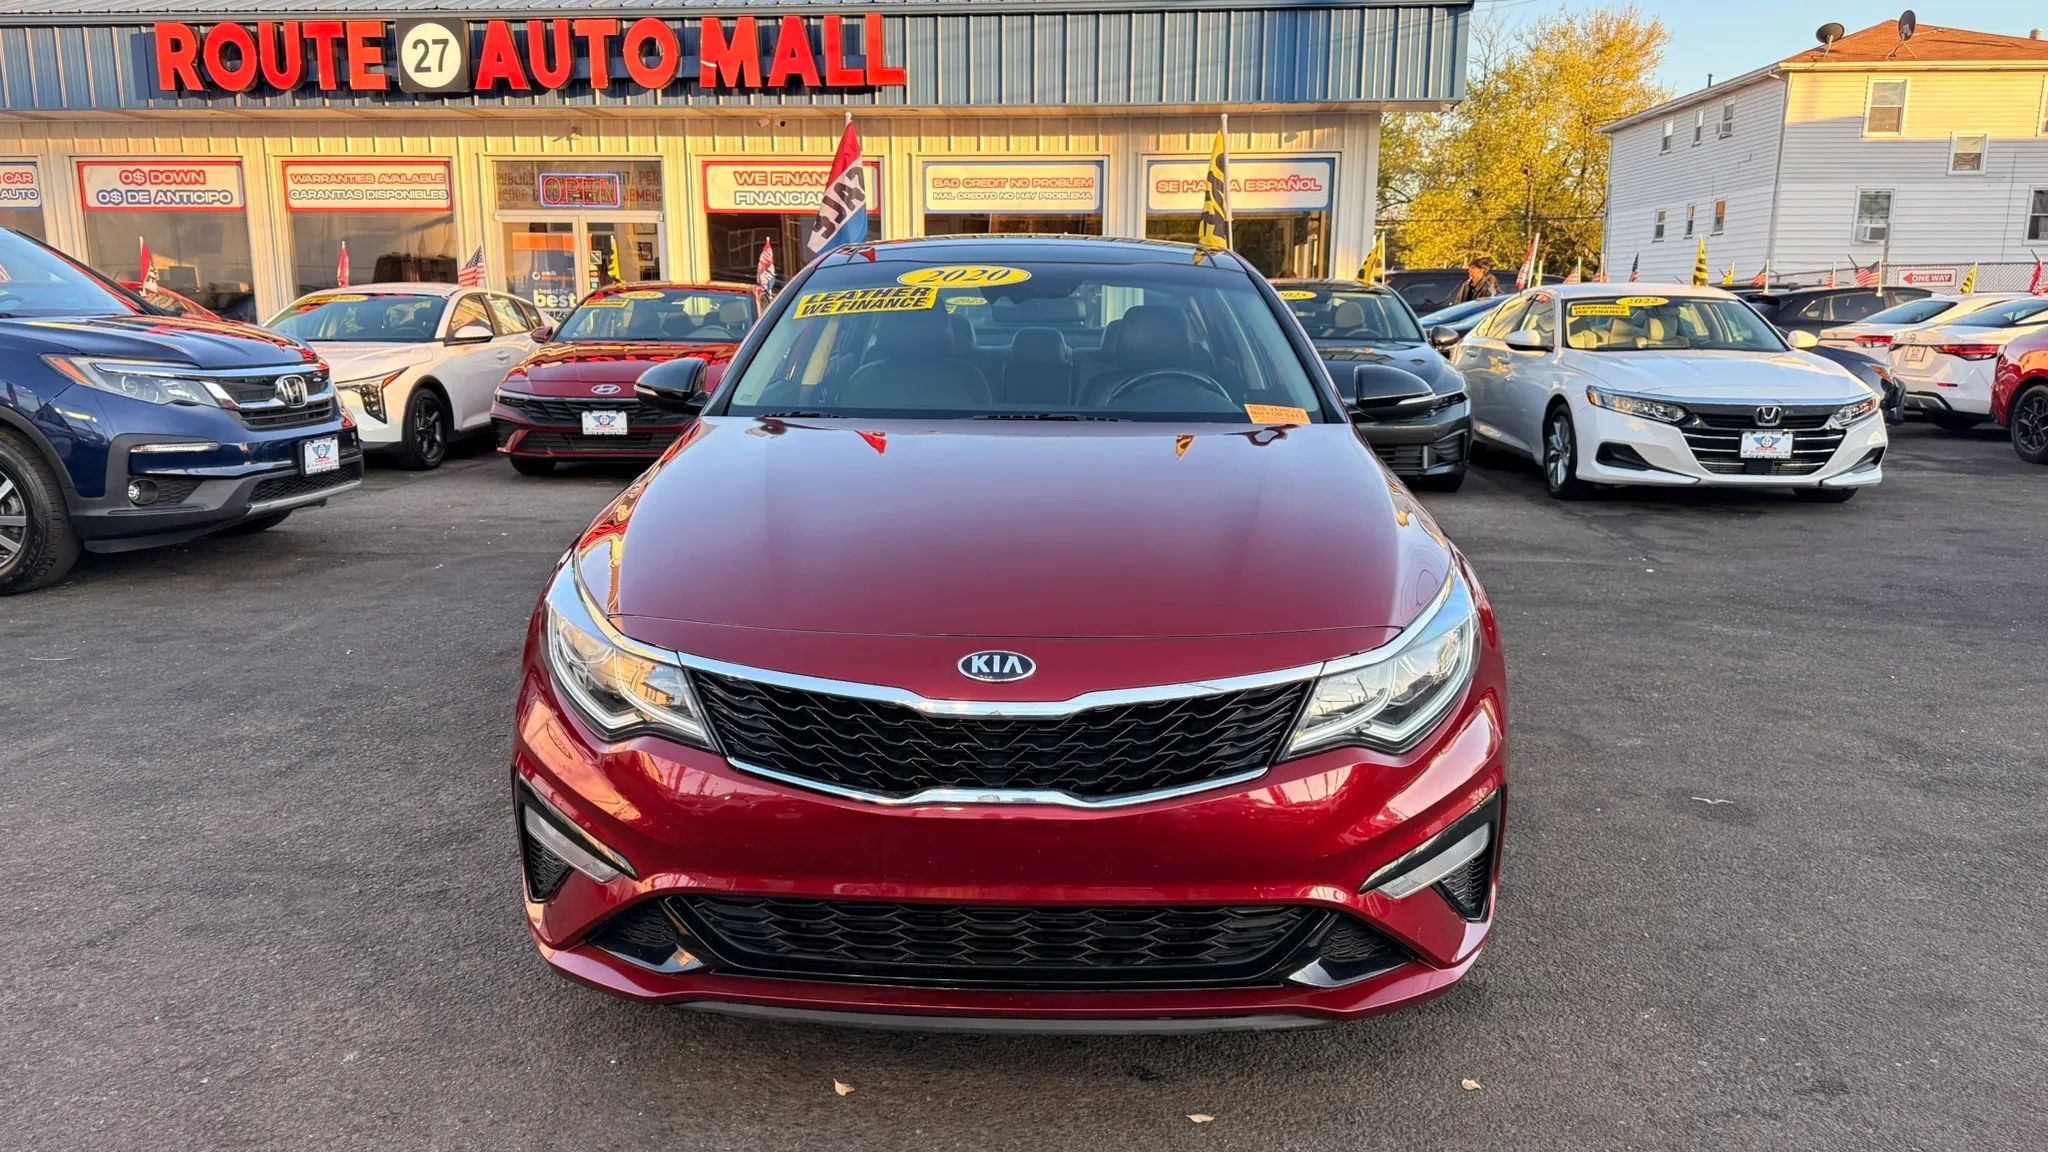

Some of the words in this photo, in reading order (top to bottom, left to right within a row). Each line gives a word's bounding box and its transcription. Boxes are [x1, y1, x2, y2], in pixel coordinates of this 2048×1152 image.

[155, 20, 391, 92] ROUTE
[412, 38, 450, 73] 27
[474, 17, 681, 90] AUTO
[699, 13, 907, 88] MALL
[3, 172, 34, 184] CAR
[150, 168, 206, 185] DOWN
[290, 173, 375, 185] WARRANTIES
[378, 173, 445, 185] AVAILABLE
[733, 170, 768, 186] WE
[932, 177, 960, 189] BAD
[962, 177, 1008, 189] CREDIT
[1010, 177, 1030, 189] NO
[1032, 177, 1094, 189] PROBLEM
[1156, 179, 1180, 193] SE
[1182, 179, 1241, 193] HAA
[1244, 174, 1322, 192] ESPAÑOL
[0, 188, 39, 200] AUTO
[125, 189, 152, 204] DE
[153, 189, 233, 205] ANTICIPO
[289, 189, 363, 200] GARANTIAS
[365, 189, 449, 200] DISPONIBLES
[542, 176, 619, 206] OPEN
[933, 191, 955, 200] MAL
[957, 191, 998, 200] CREDITO
[999, 191, 1015, 200] NO
[1016, 191, 1037, 200] HAY
[1038, 191, 1093, 200] PROBLEMA
[917, 268, 1011, 284] 2020
[533, 289, 577, 308] best
[804, 287, 933, 304] LEATHER
[801, 302, 831, 316] WE
[835, 297, 931, 313] FINANCE
[971, 655, 1024, 674] KIA
